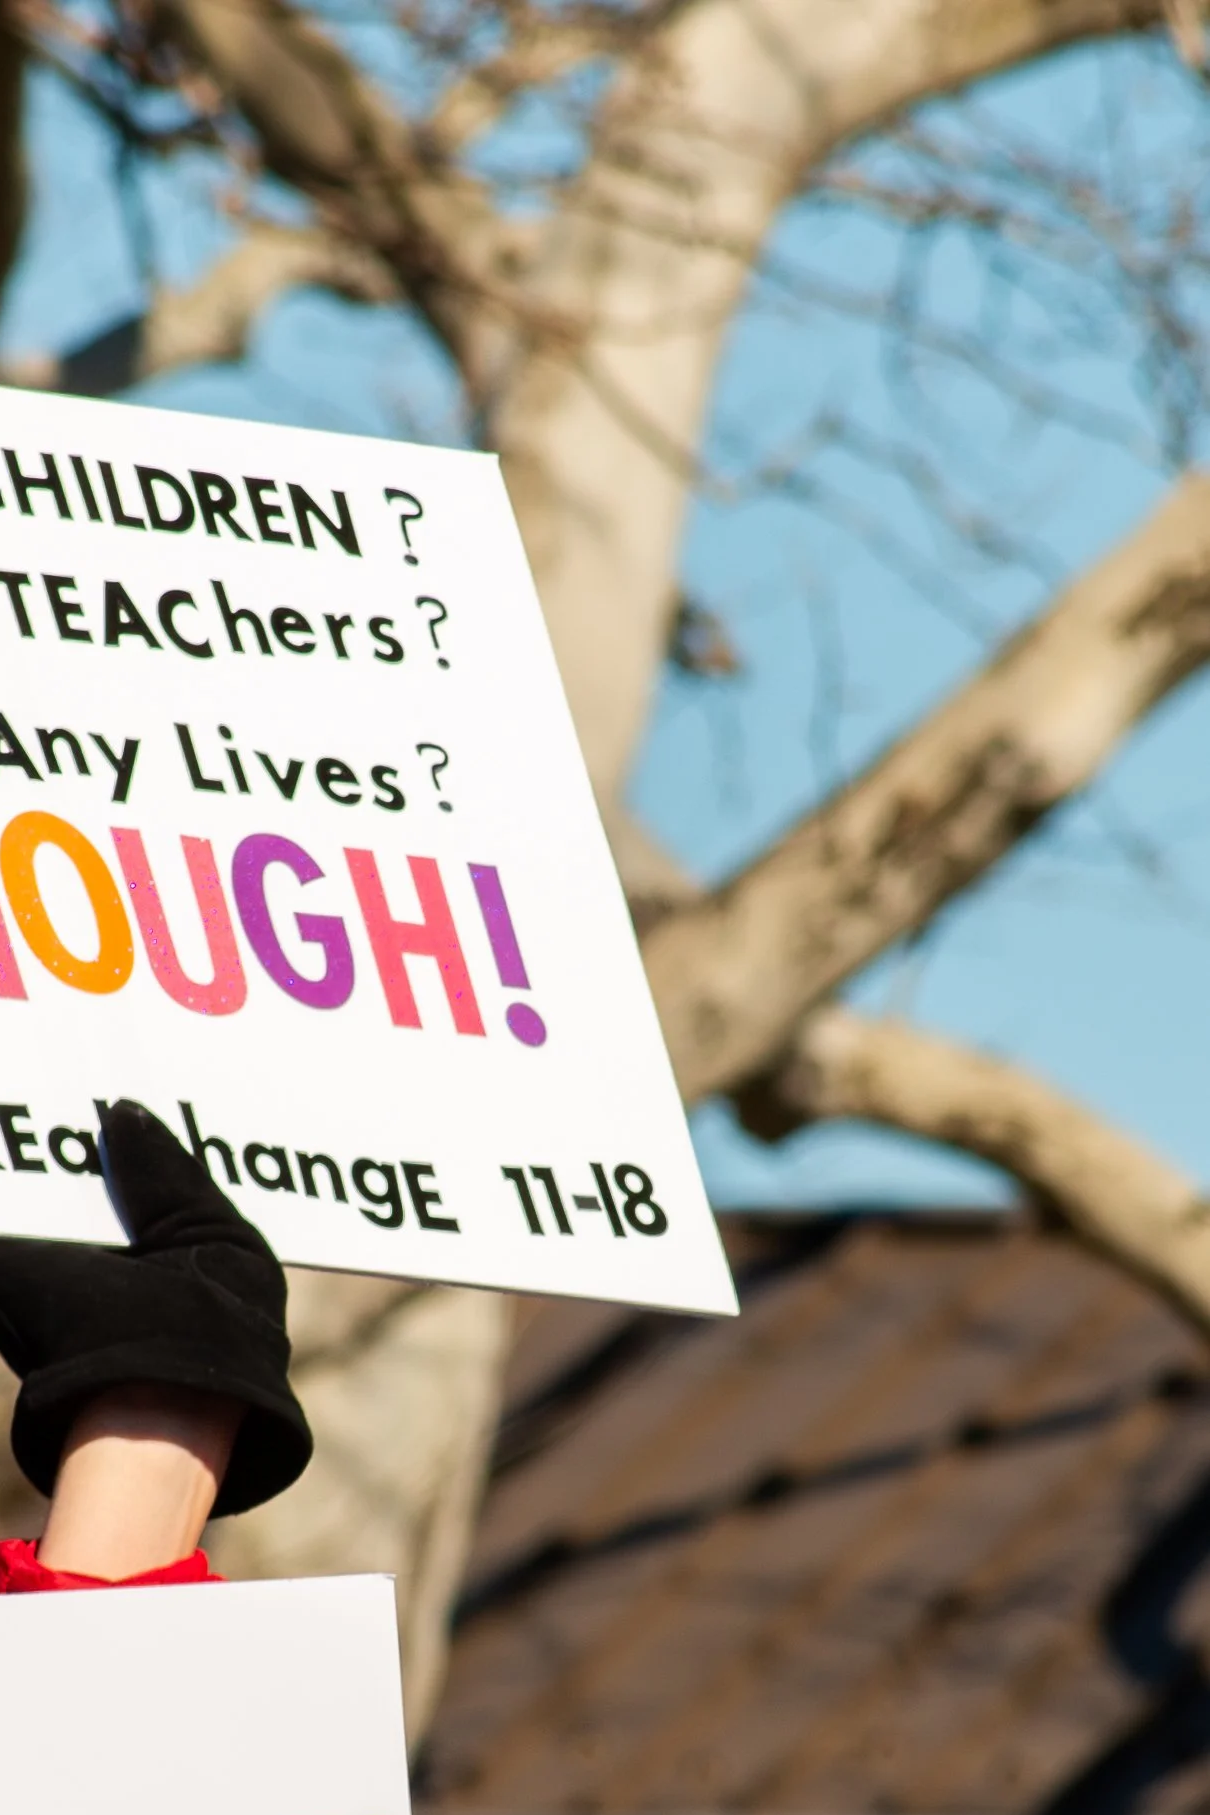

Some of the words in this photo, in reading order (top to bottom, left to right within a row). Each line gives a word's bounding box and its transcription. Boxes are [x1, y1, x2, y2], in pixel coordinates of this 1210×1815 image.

[175, 723, 455, 812] Lives?
[178, 1100, 461, 1233] hangE
[501, 1162, 669, 1237] 11-18
